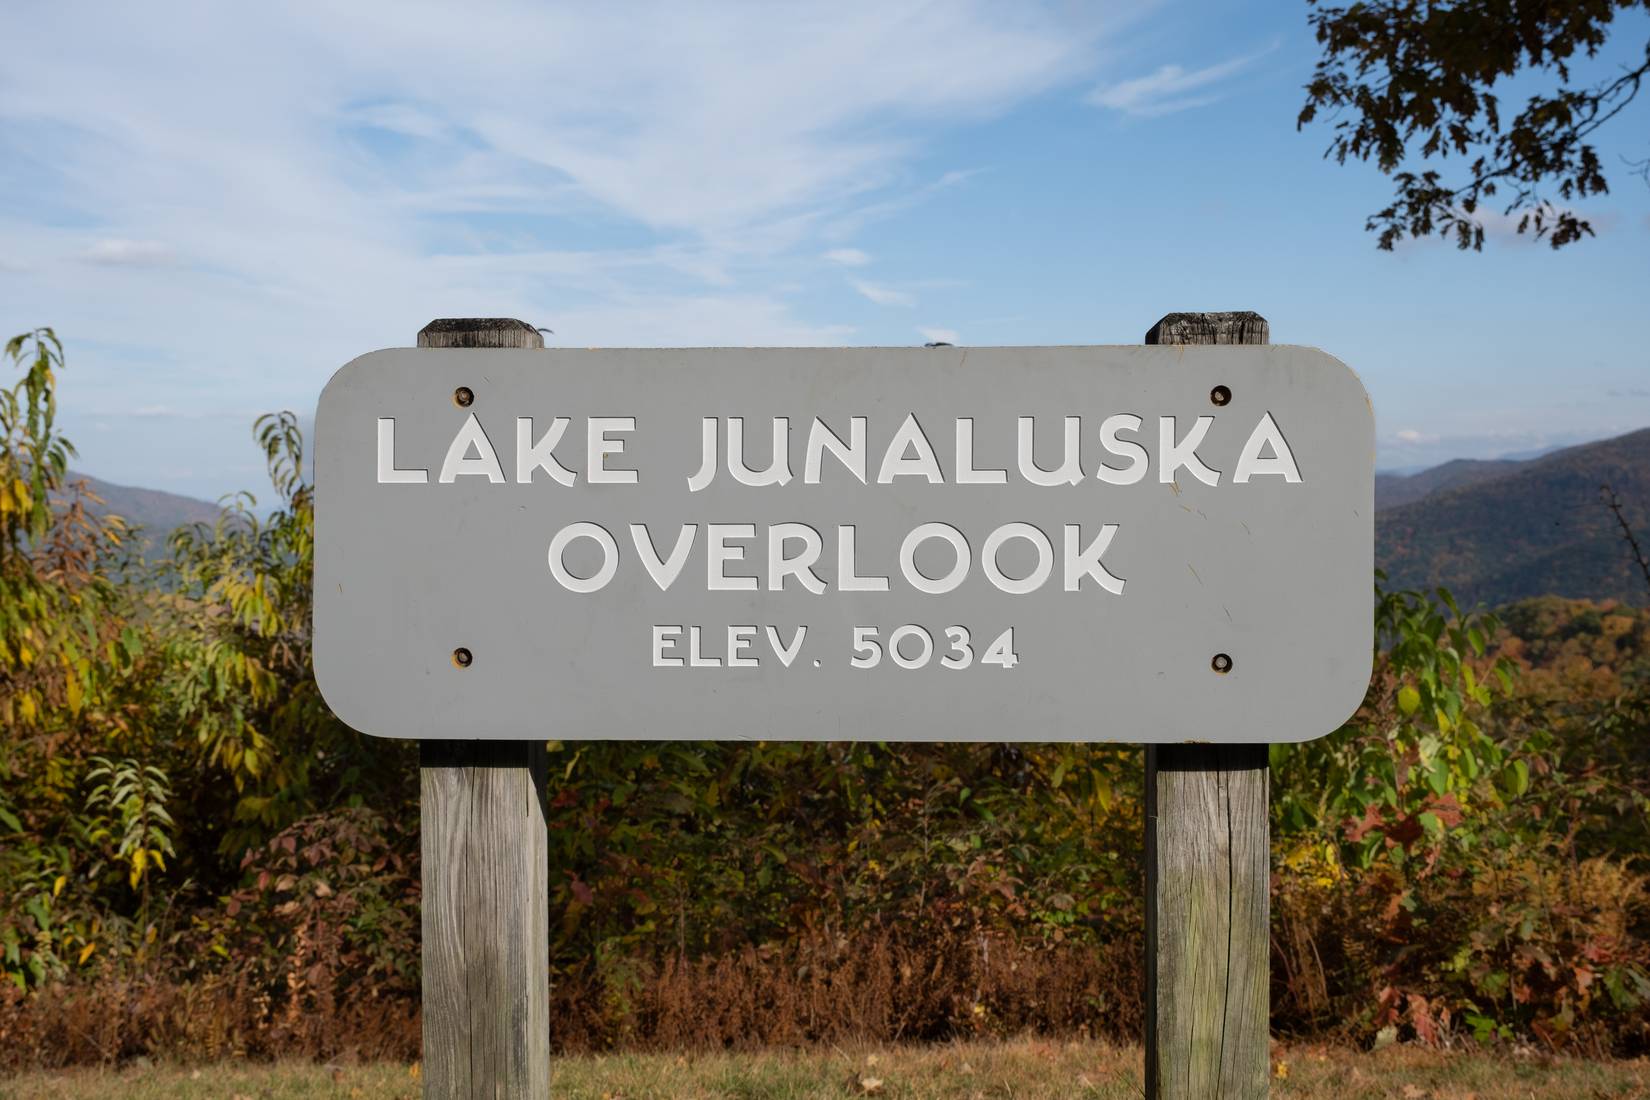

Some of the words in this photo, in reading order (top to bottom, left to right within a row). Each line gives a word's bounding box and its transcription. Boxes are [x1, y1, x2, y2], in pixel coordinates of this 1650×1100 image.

[376, 413, 639, 486] LAKE
[686, 412, 1303, 492] JUNALUSKA
[547, 521, 1127, 595] OVERLOOK
[651, 624, 821, 669] ELEV.
[849, 624, 1020, 670] 5034
